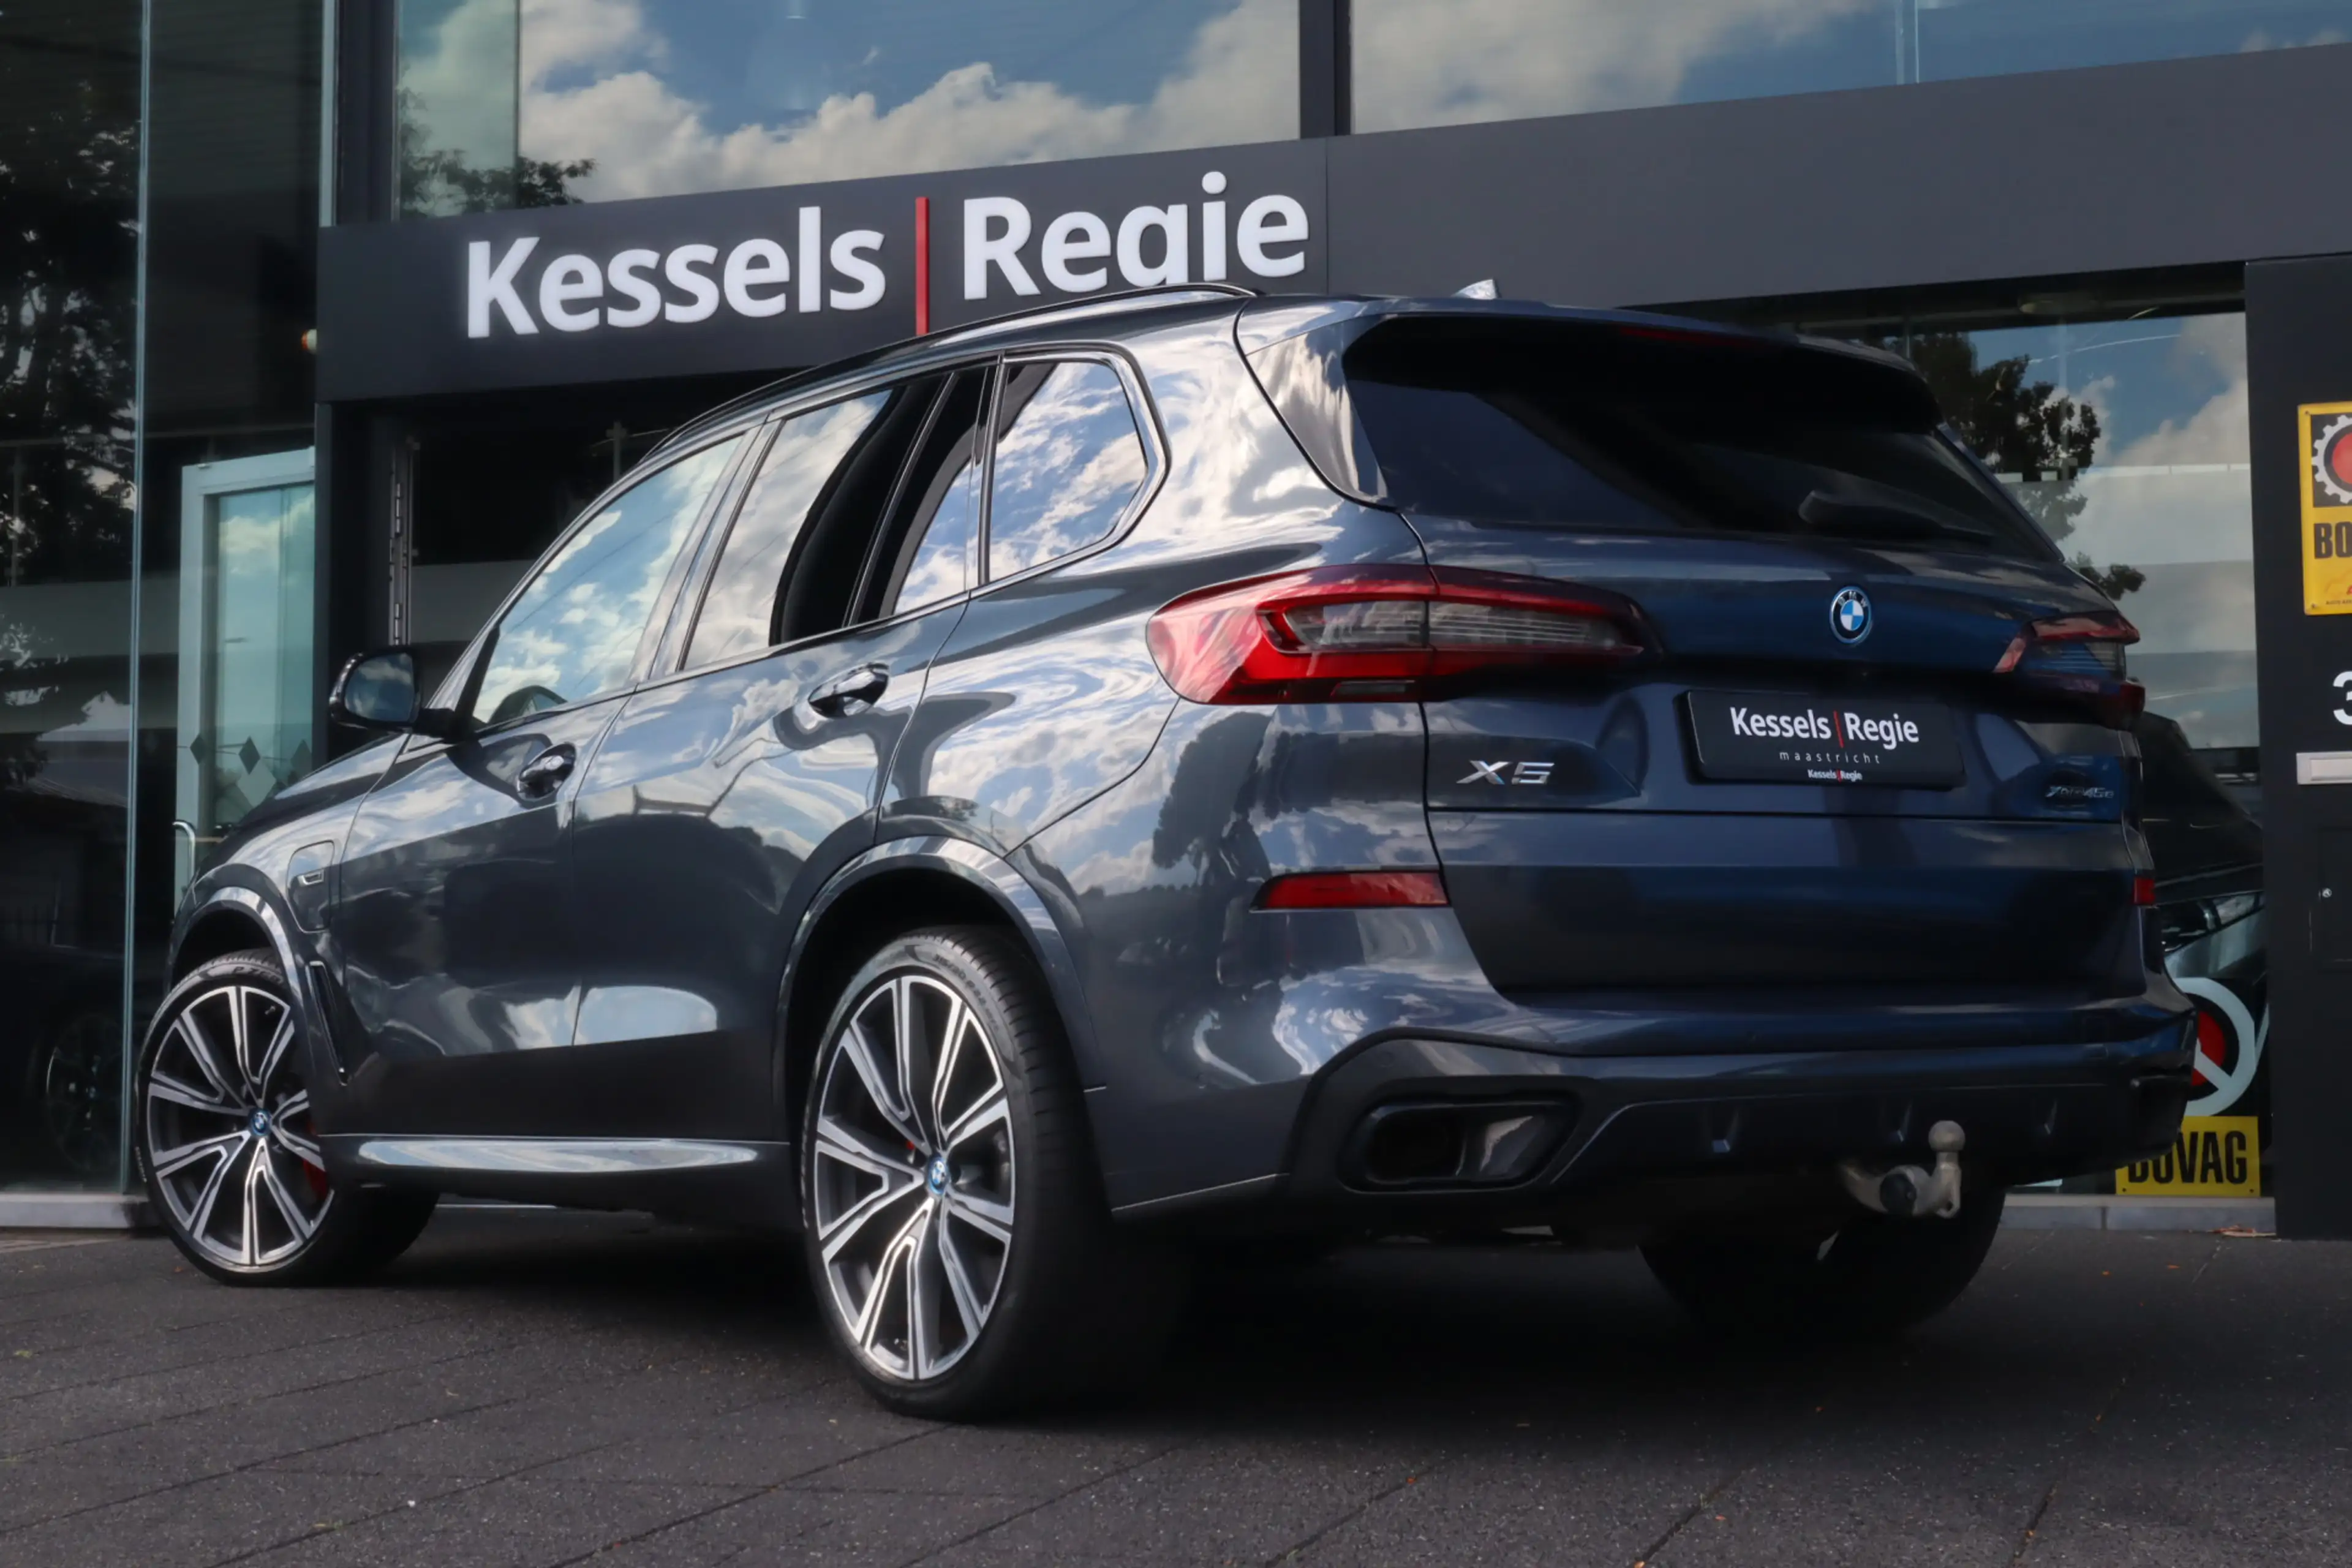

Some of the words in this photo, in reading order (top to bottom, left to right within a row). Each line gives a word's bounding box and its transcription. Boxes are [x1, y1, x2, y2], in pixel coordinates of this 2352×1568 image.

[467, 207, 886, 337] Kessels
[963, 171, 1308, 300] Regie
[1729, 706, 1831, 739] Kessels
[1844, 712, 1920, 750] Regie
[1779, 751, 1880, 764] maastricht
[1455, 760, 1555, 785] X5
[1807, 769, 1837, 780] Kessels
[1840, 770, 1863, 782] Regie
